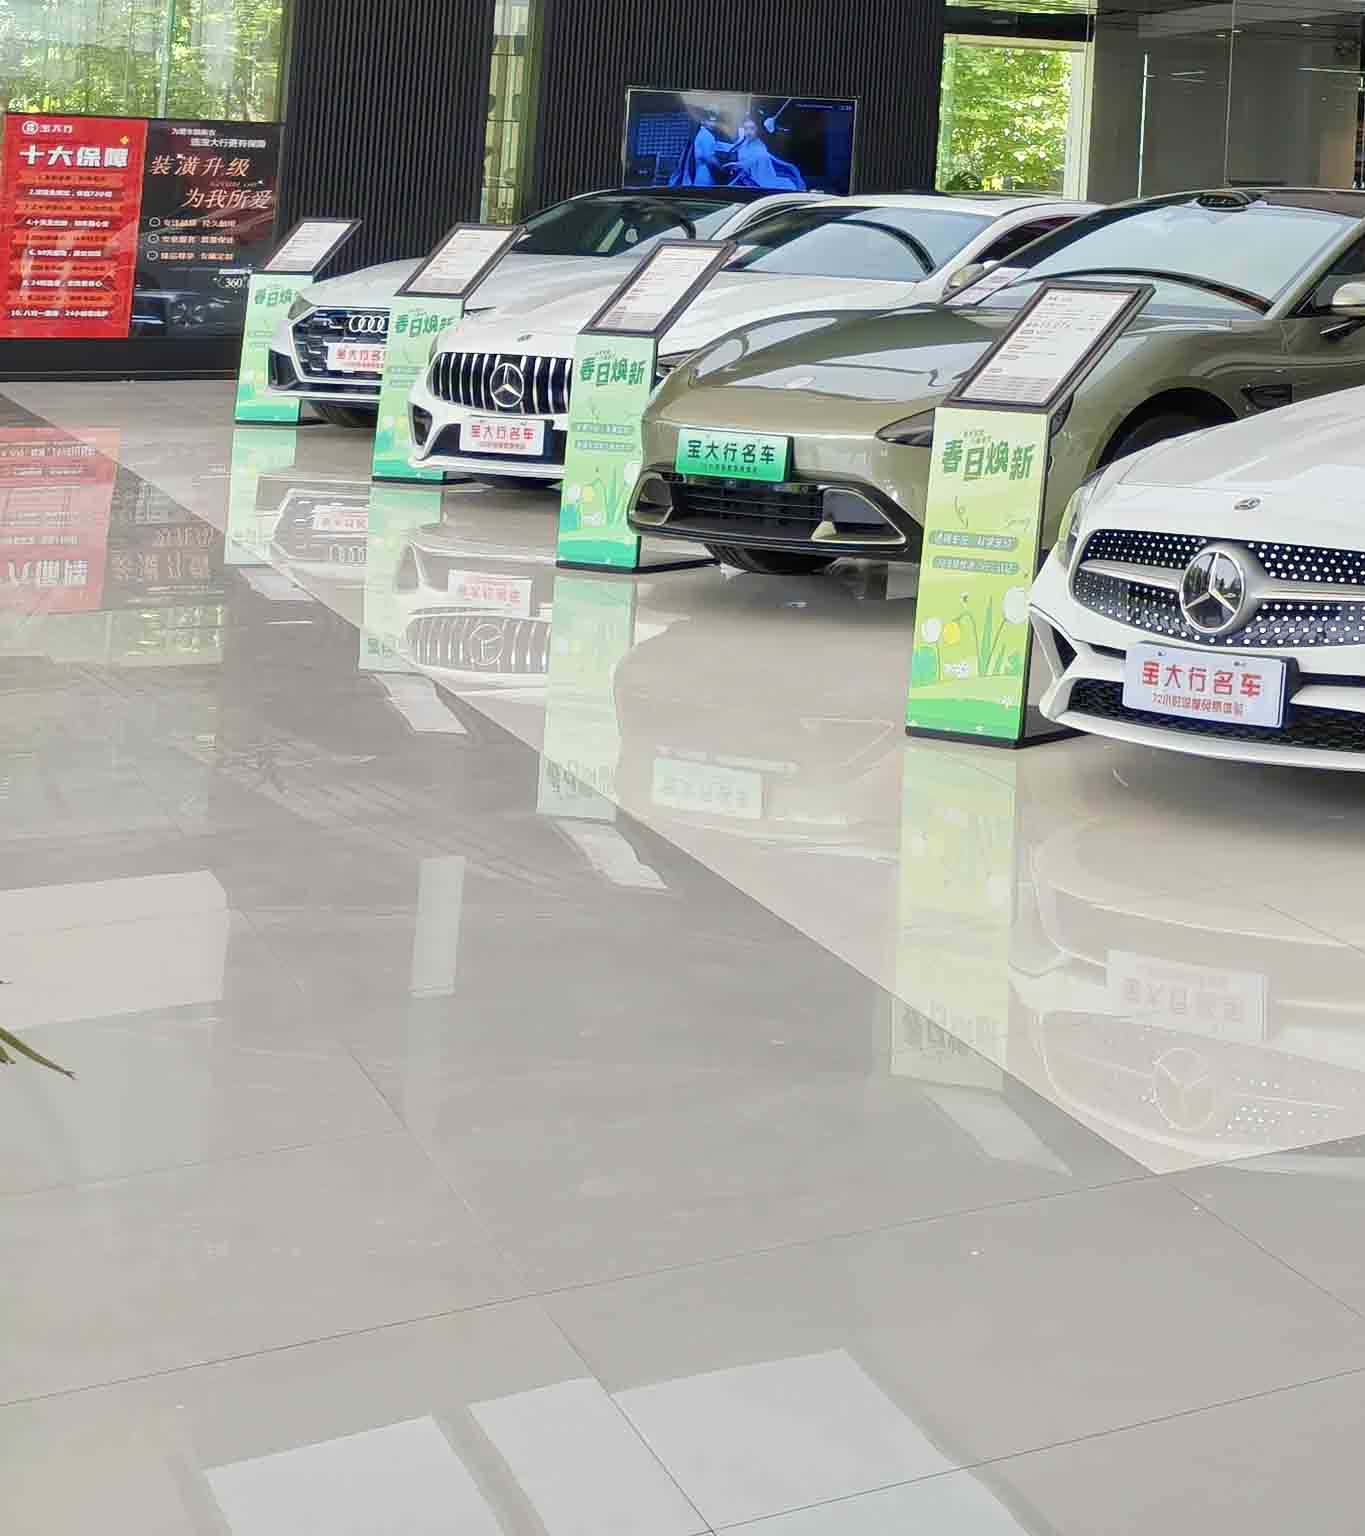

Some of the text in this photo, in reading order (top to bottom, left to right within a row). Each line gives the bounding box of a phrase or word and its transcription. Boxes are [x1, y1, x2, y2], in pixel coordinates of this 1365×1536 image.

[19, 144, 129, 168] 十大保障
[150, 154, 251, 177] 装潢升级
[181, 187, 273, 209] 为我所爱
[255, 287, 298, 306] 春日焕
[581, 357, 648, 387] 春日焕新
[687, 439, 777, 465] 宝大行名车
[942, 439, 1036, 481] 春日焕新
[1141, 660, 1264, 699] 宝大行名车
